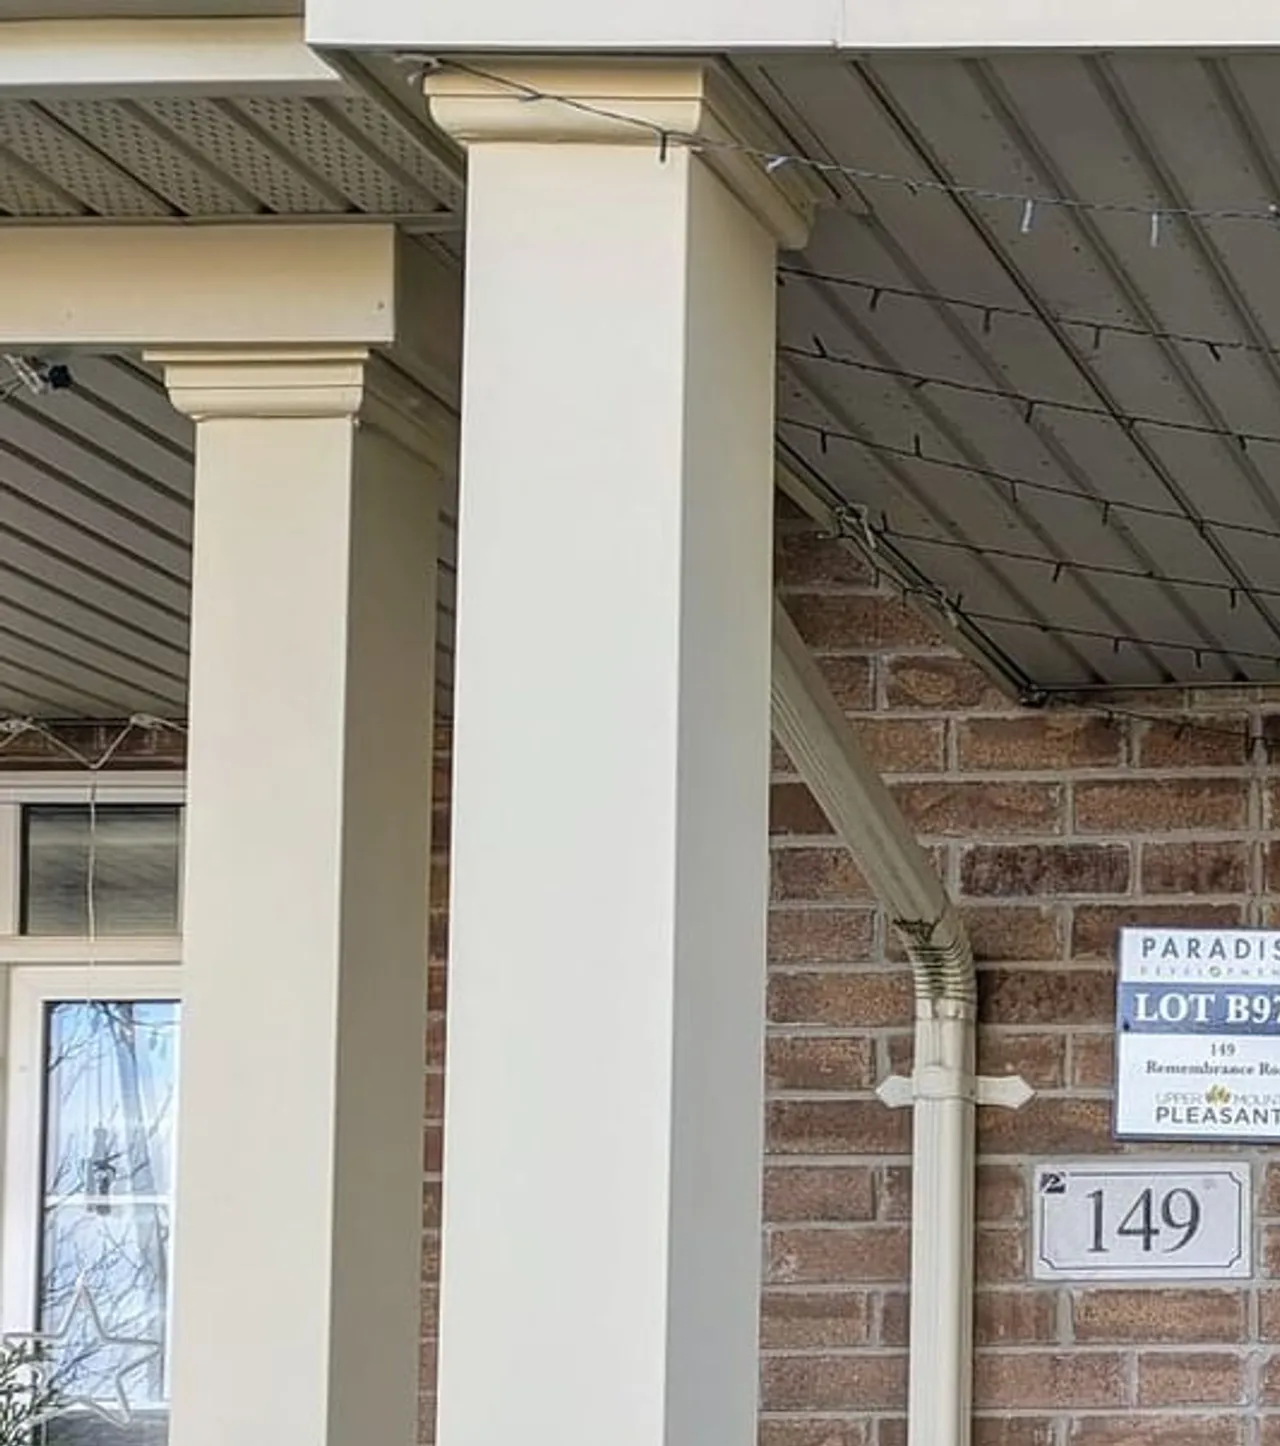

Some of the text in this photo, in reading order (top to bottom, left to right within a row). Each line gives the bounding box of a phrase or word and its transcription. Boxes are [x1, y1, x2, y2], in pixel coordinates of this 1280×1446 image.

[1135, 993, 1215, 1021] LOT
[1211, 1043, 1235, 1056] 149
[1146, 1060, 1254, 1075] Remembrance
[1156, 1092, 1200, 1105] UPPER
[1086, 1188, 1201, 1253] 149
